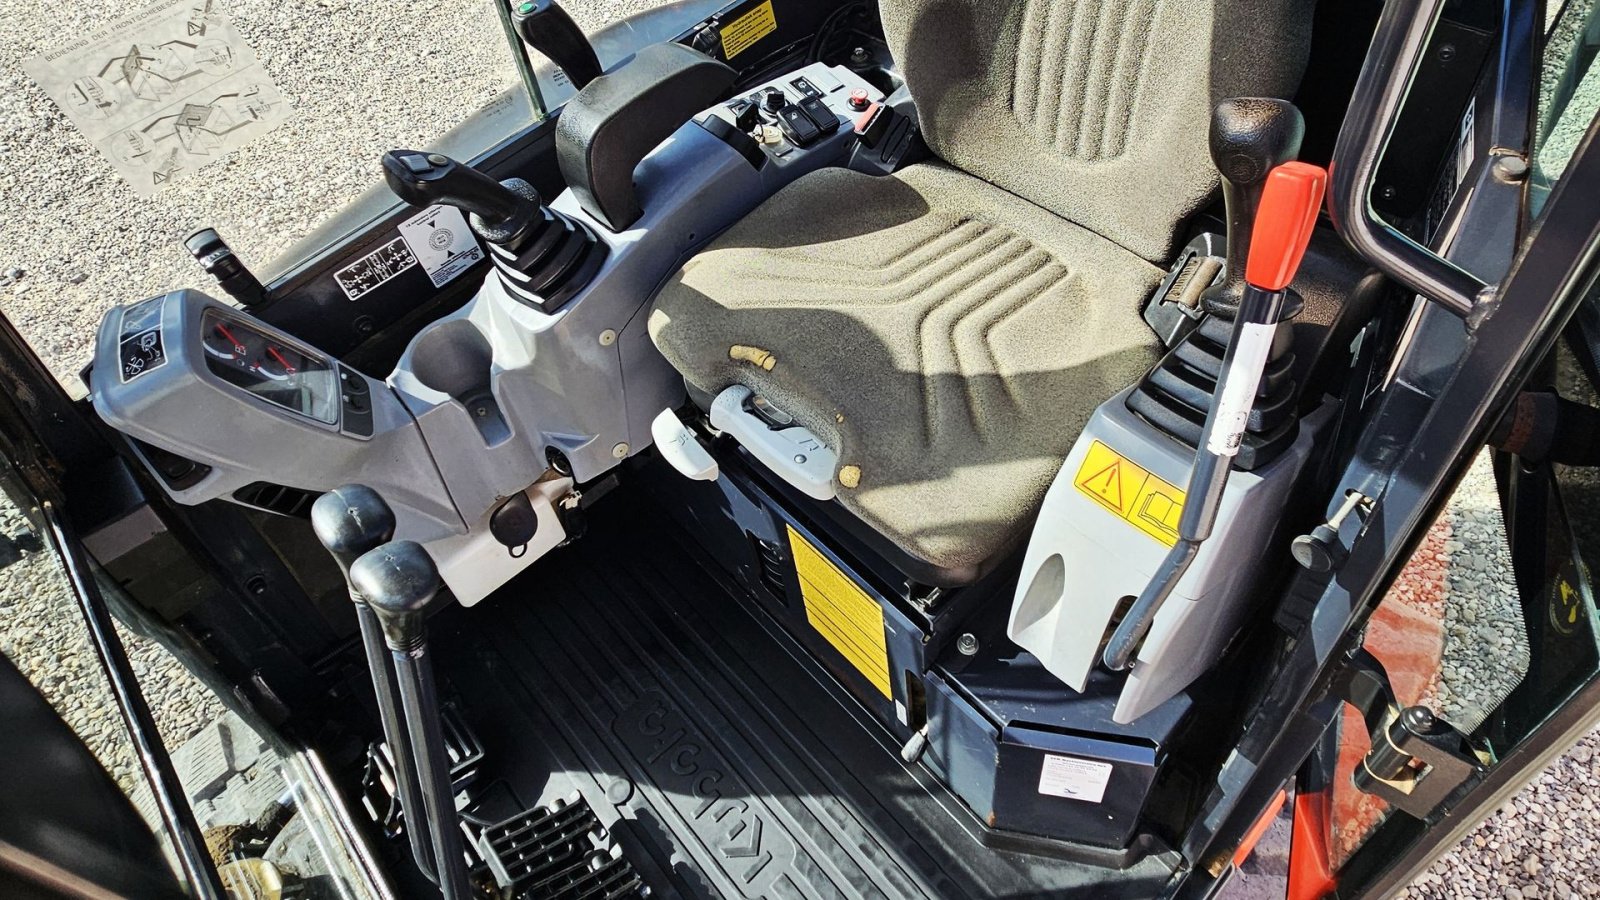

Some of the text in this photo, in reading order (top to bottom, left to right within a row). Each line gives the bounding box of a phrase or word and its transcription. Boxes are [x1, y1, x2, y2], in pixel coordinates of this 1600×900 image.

[45, 39, 89, 62] BEDIENUNG
[91, 30, 109, 41] DER
[639, 701, 773, 884] Kubota
